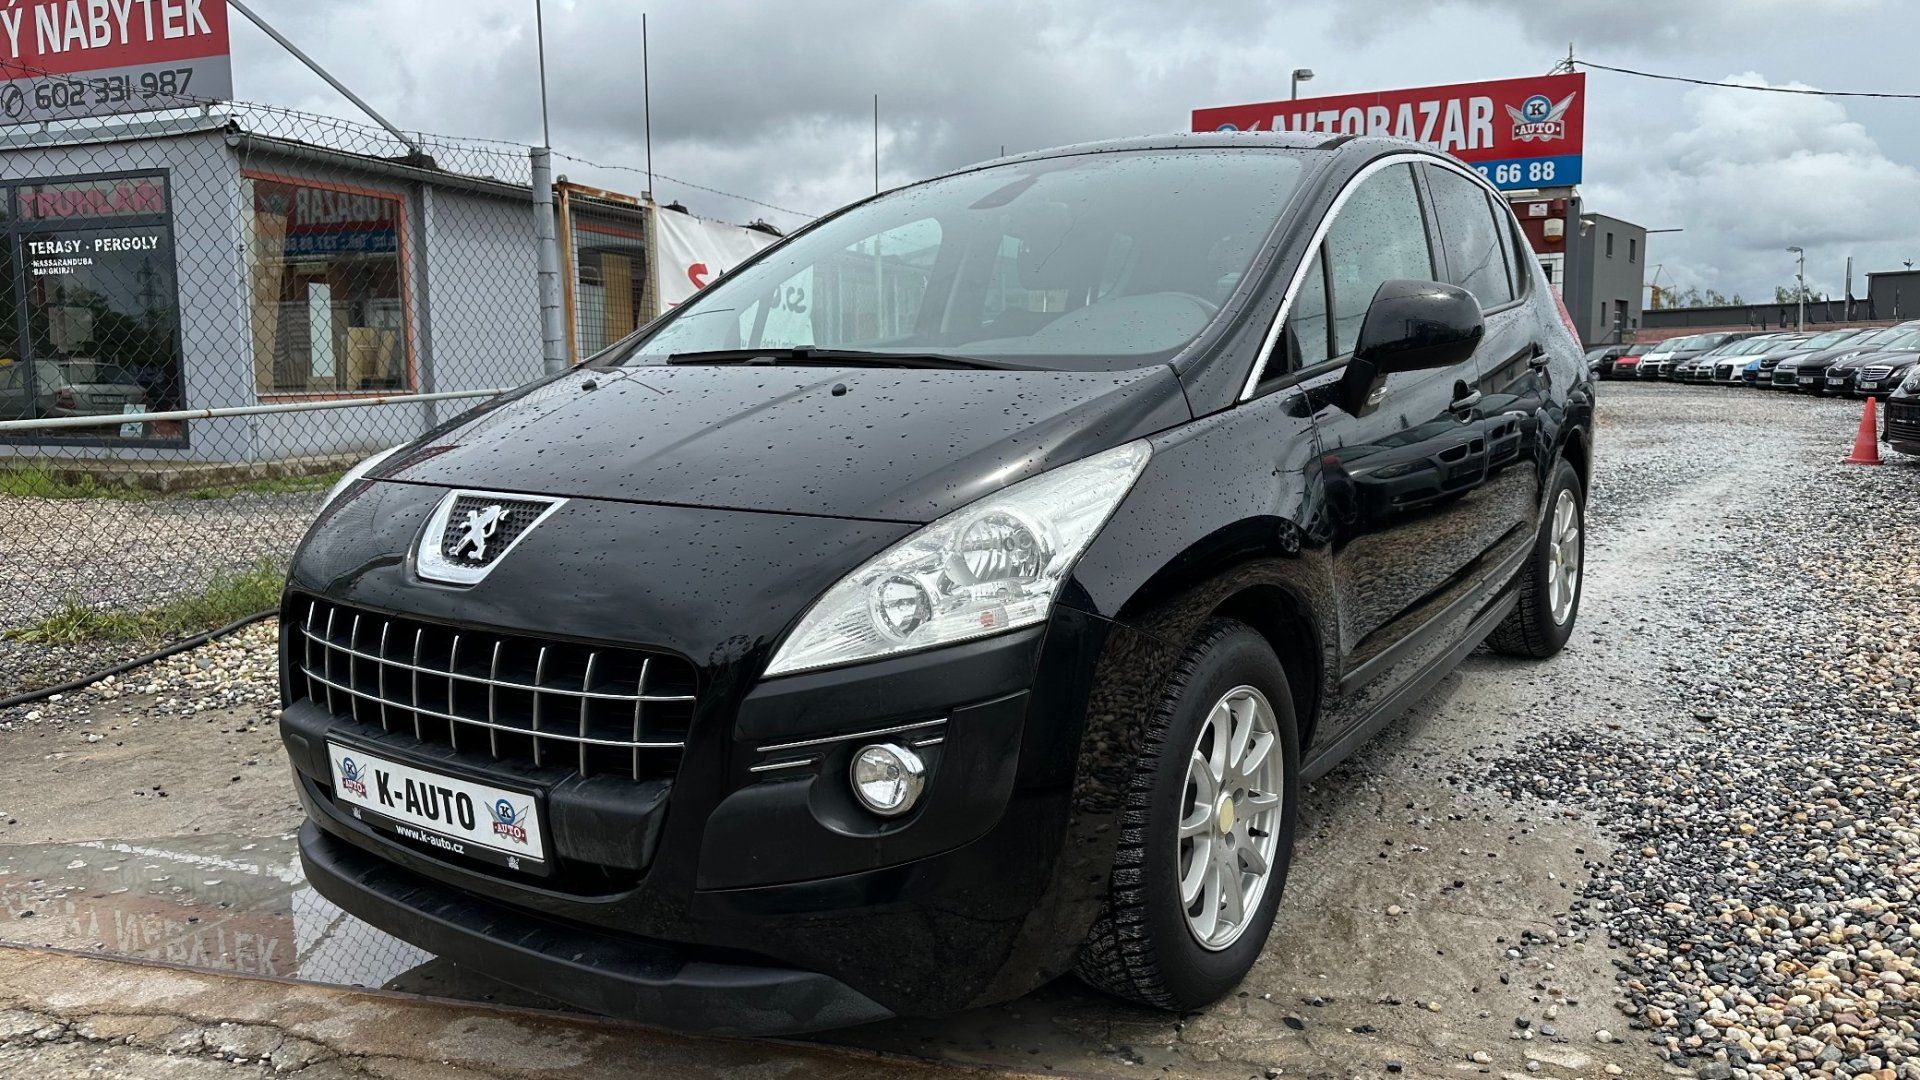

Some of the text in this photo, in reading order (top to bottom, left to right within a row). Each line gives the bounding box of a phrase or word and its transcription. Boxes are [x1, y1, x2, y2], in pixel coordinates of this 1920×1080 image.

[35, 68, 193, 110] 602 331 987
[1529, 103, 1545, 116] K
[1519, 122, 1555, 135] AUTO
[1496, 163, 1521, 183] 66
[1529, 161, 1555, 181] 88
[28, 236, 158, 255] TERASY PERGOLY
[346, 763, 355, 775] K
[375, 769, 476, 831] K-AUTO
[500, 805, 511, 818] K
[497, 824, 521, 838] AUTO
[396, 824, 464, 855] www.k-auto.cz
